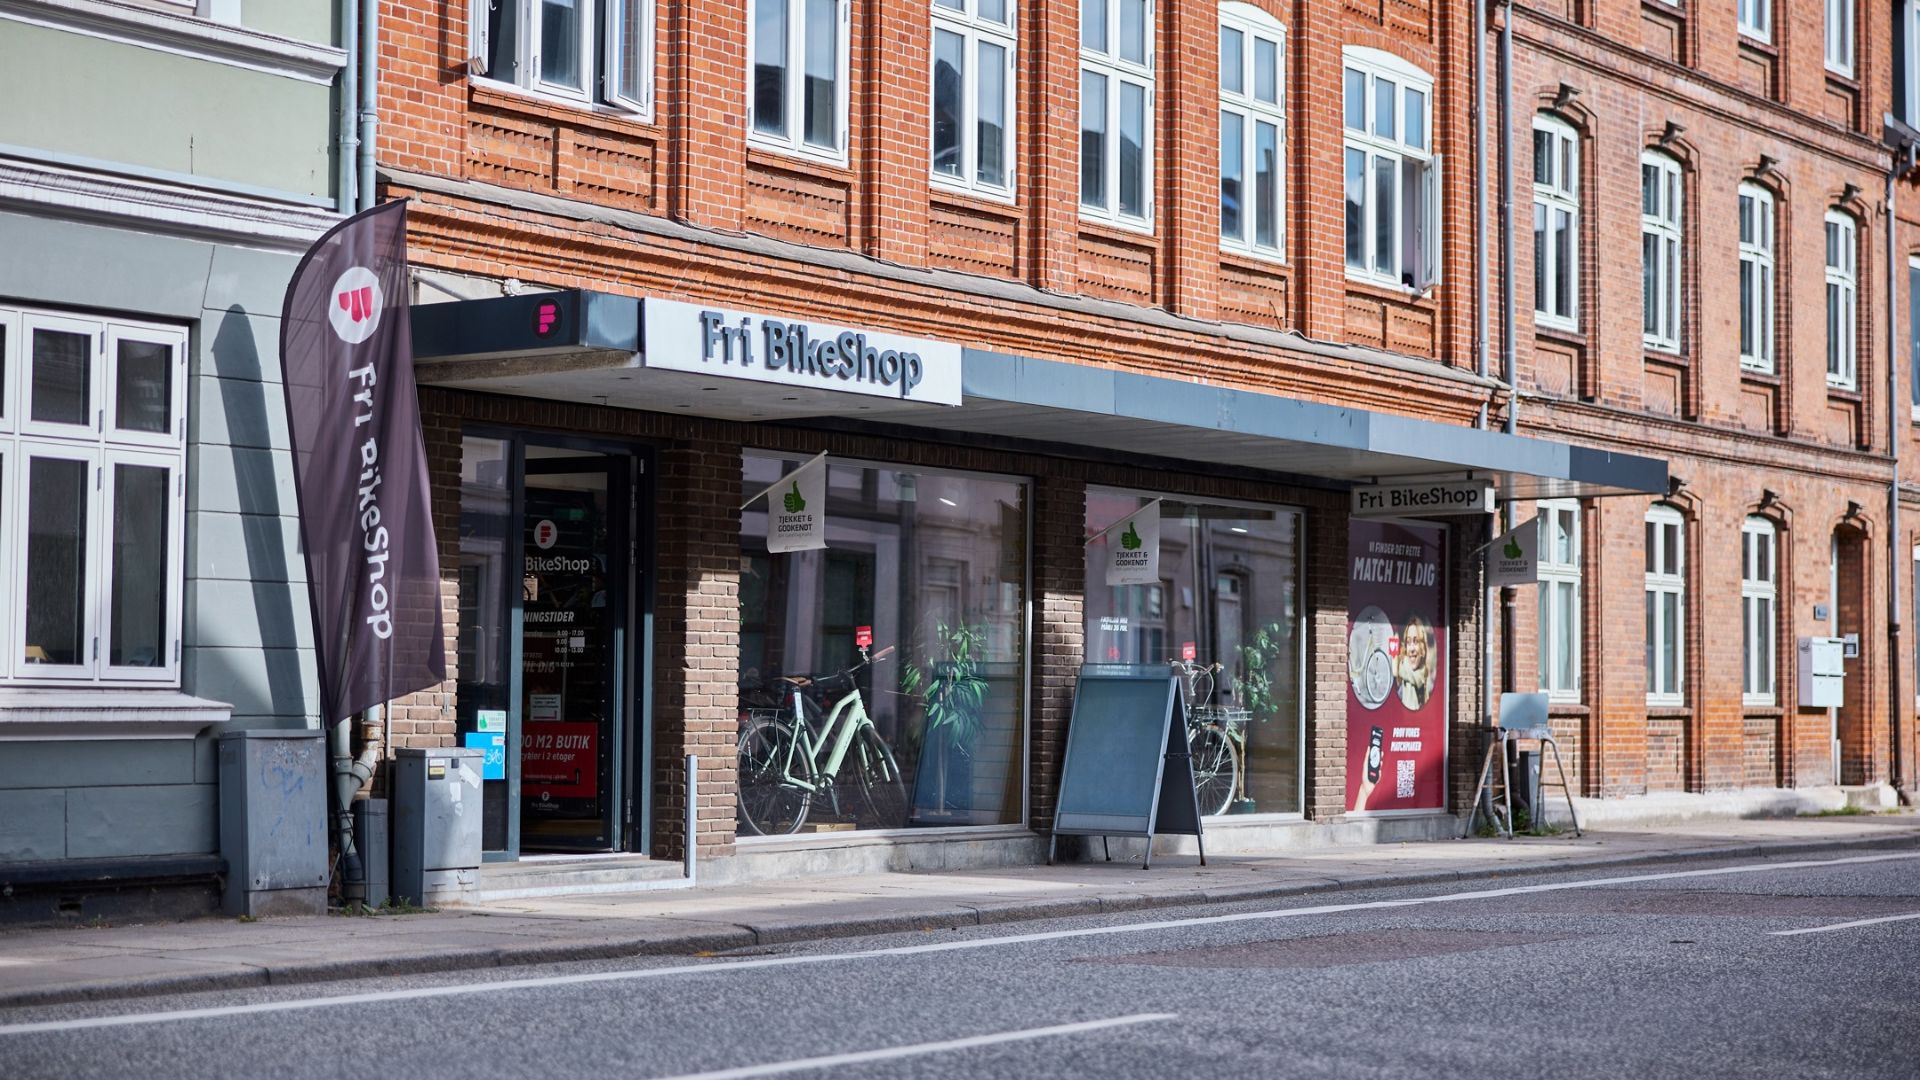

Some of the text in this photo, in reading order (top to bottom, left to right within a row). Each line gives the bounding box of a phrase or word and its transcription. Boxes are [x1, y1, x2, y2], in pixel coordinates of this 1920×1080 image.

[699, 310, 923, 397] Fri BikeShop
[1359, 487, 1478, 508] Fri BikeShop
[779, 515, 806, 523] TJEKKET
[778, 524, 812, 532] GODKENDT
[358, 437, 392, 640] BikeShop
[1116, 551, 1141, 559] TJEKKET
[525, 556, 590, 574] BikeShop
[1353, 557, 1435, 587] MATCH TIL DIG
[536, 735, 553, 748] M2
[556, 735, 590, 749] BUTIK
[552, 752, 576, 762] etager
